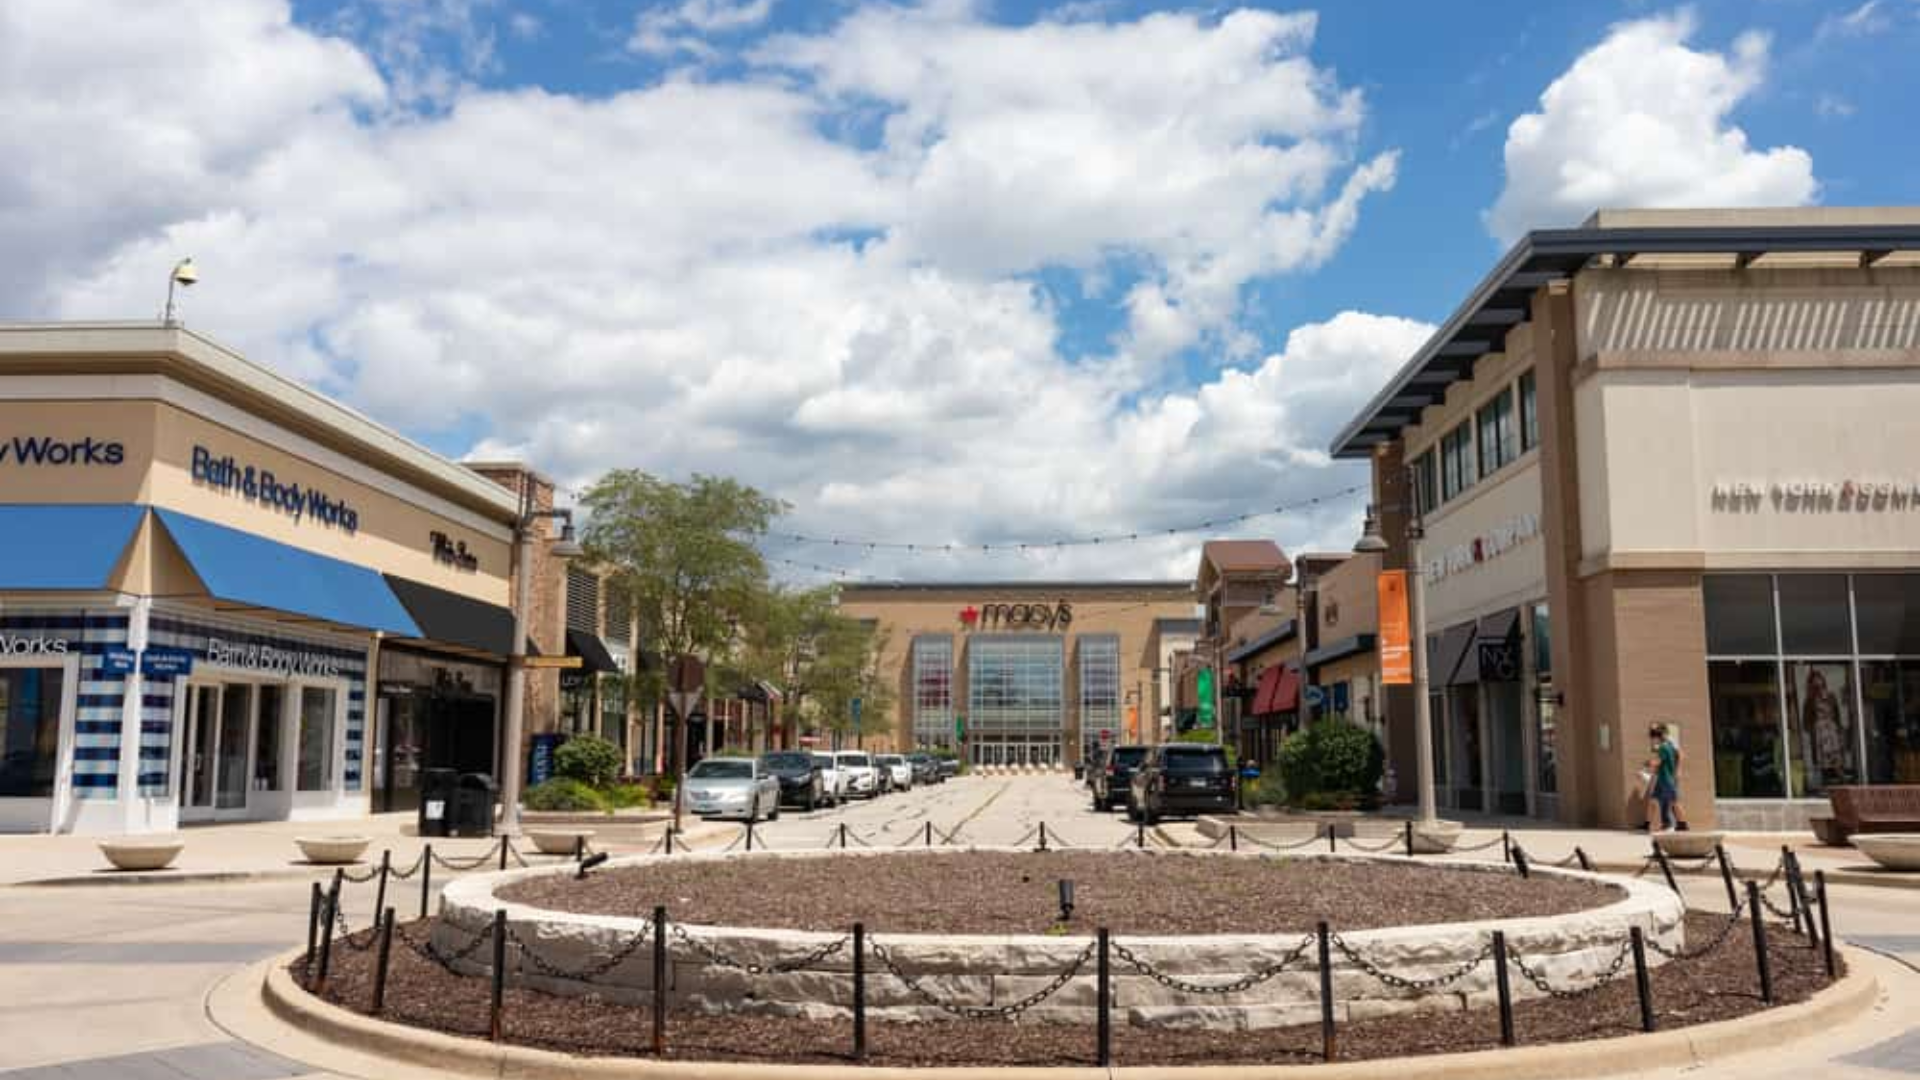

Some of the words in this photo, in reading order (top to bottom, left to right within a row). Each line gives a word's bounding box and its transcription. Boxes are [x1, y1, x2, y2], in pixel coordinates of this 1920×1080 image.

[12, 436, 124, 465] Works
[192, 445, 242, 493] Bath
[242, 465, 258, 499] &
[259, 470, 306, 524] Body
[306, 488, 359, 533] Works
[208, 637, 246, 669] Bath
[260, 645, 297, 677] Body
[297, 651, 339, 678] Works
